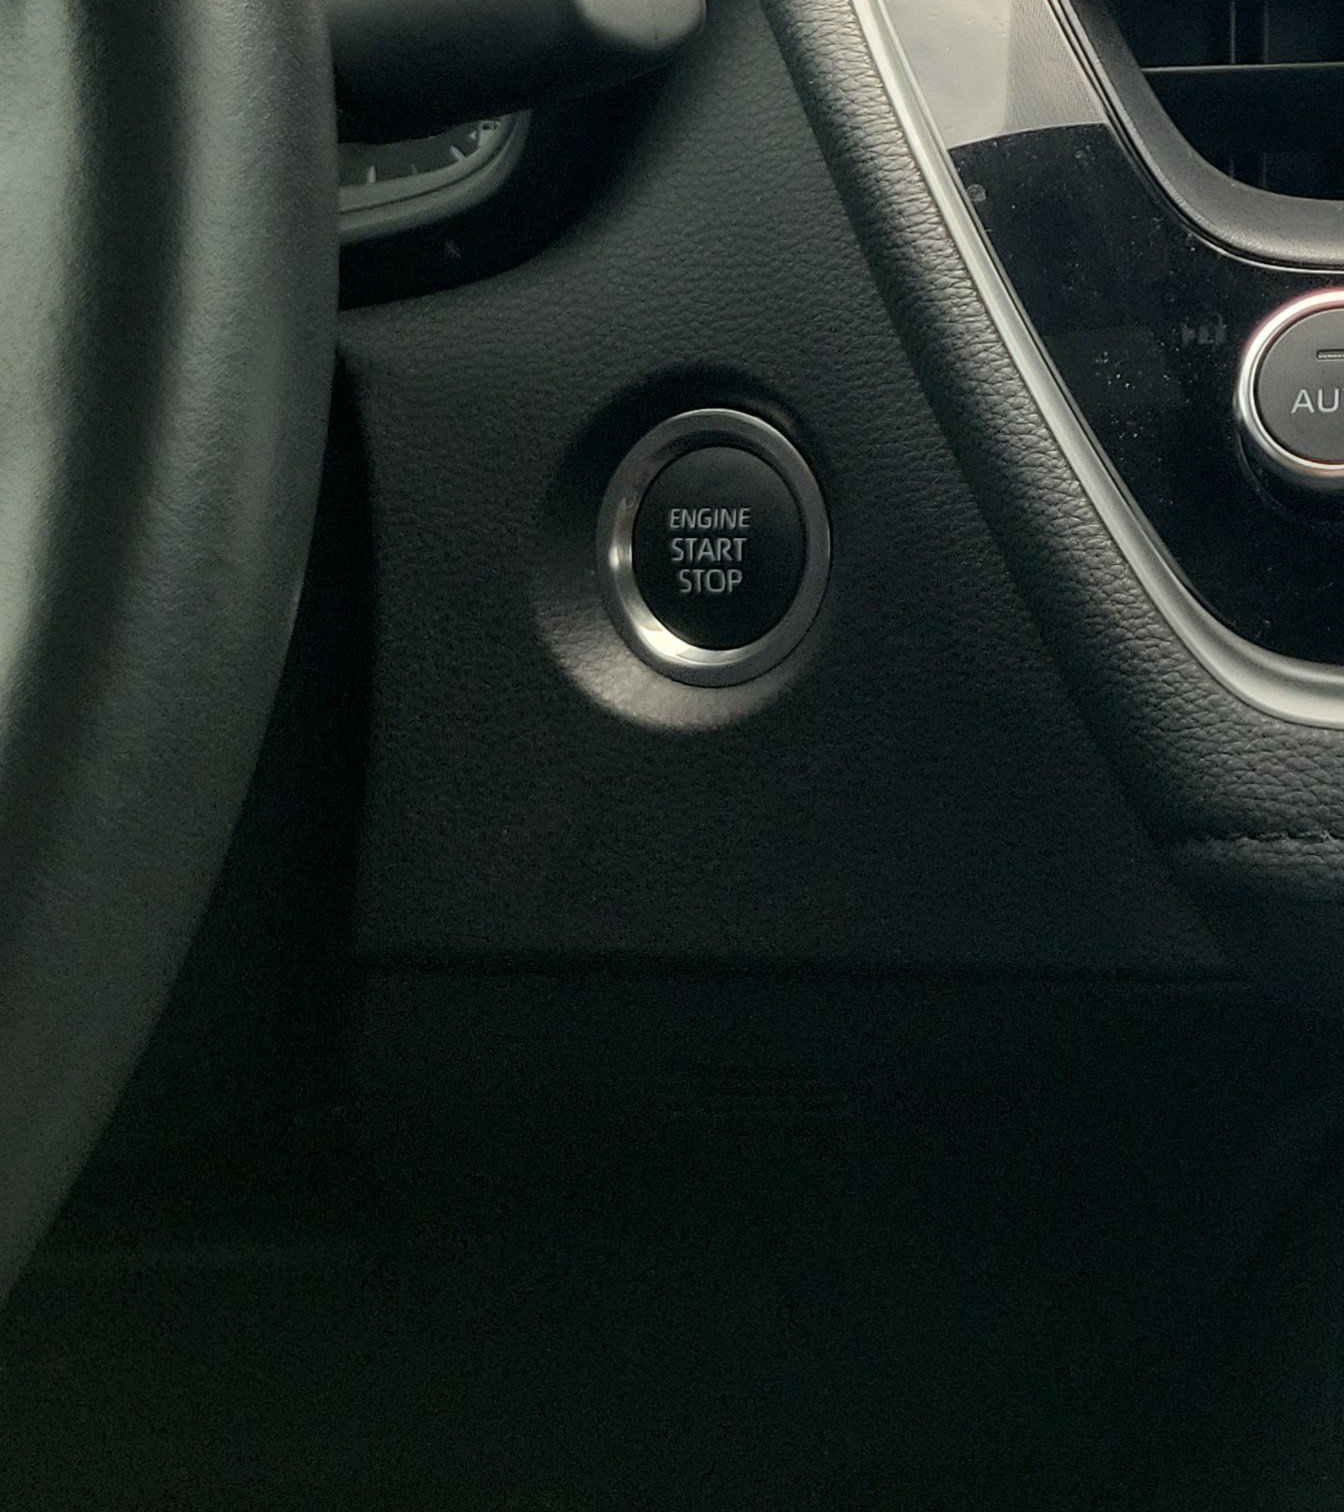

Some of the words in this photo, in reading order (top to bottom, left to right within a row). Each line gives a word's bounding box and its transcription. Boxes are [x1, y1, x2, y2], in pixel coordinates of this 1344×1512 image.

[669, 507, 751, 530] ENGINE
[671, 537, 748, 563] START
[679, 568, 743, 594] STOP
